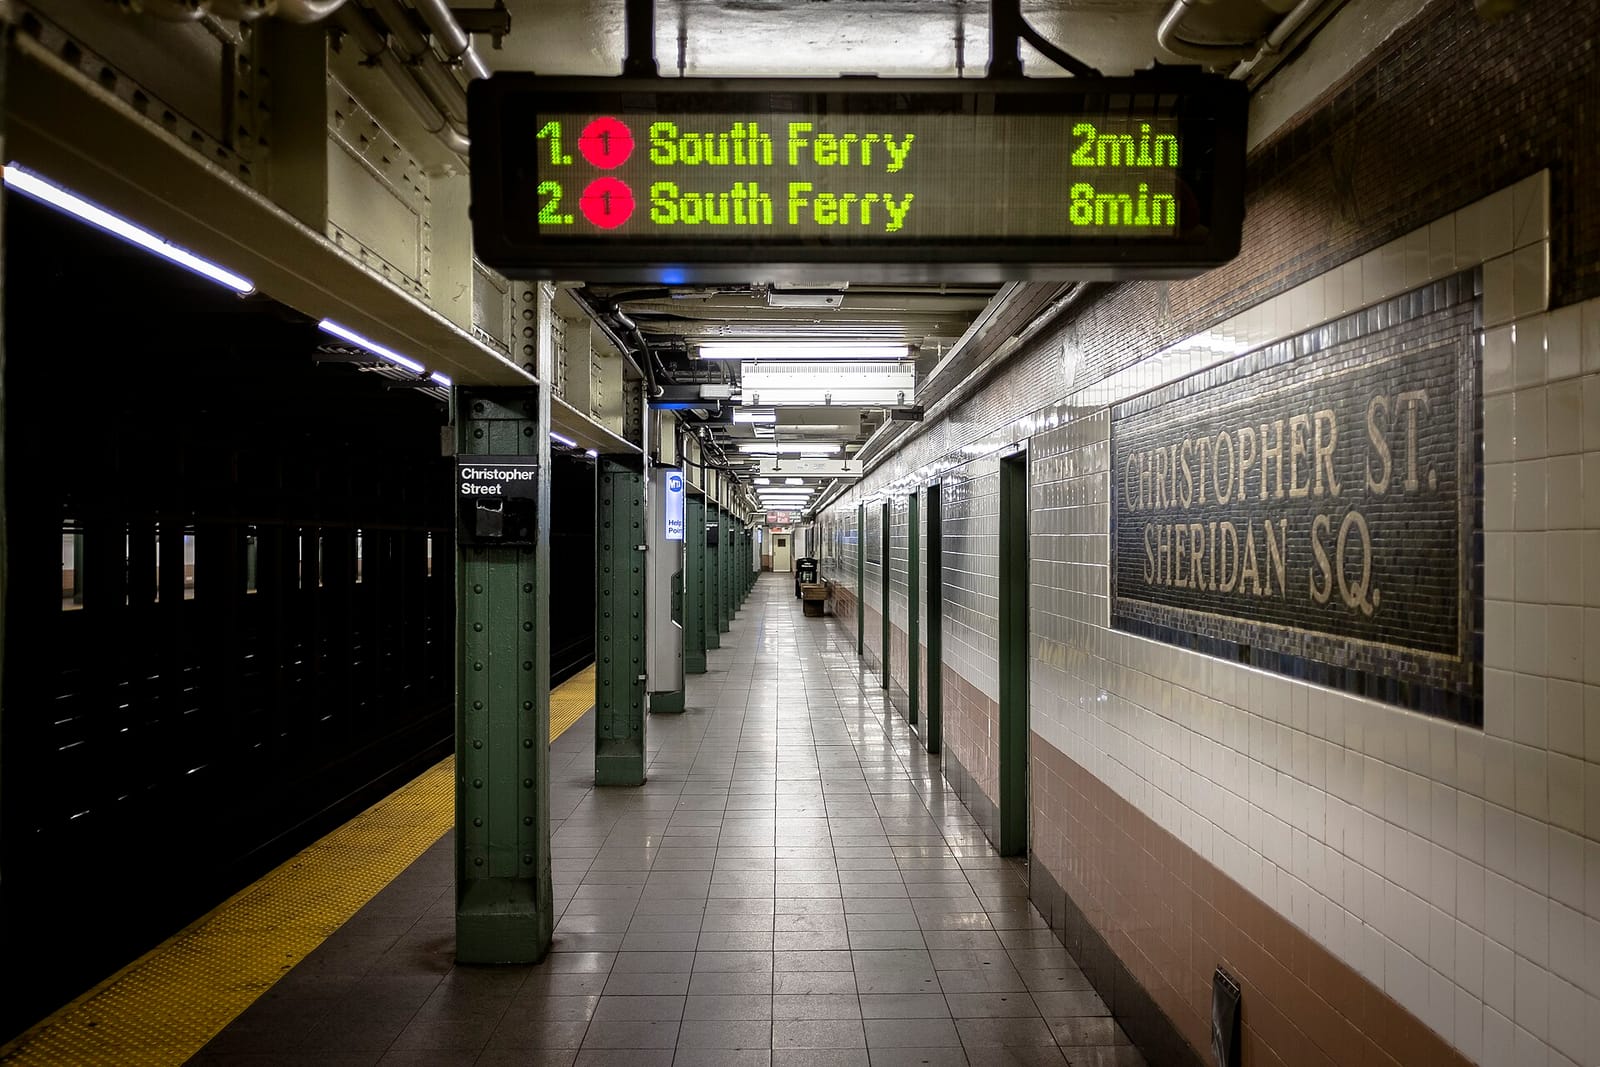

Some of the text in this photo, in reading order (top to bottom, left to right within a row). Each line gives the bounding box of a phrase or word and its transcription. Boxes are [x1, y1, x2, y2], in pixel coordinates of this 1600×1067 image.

[536, 121, 1178, 173] 1. 1 South Ferry 2min
[537, 181, 1175, 232] 2. 1 South Ferry 8min
[461, 467, 535, 482] Christopher
[1124, 388, 1438, 513] CHRISTOPHER ST.
[461, 482, 502, 495] Street
[1143, 511, 1381, 617] SHERIDAN SQ.
